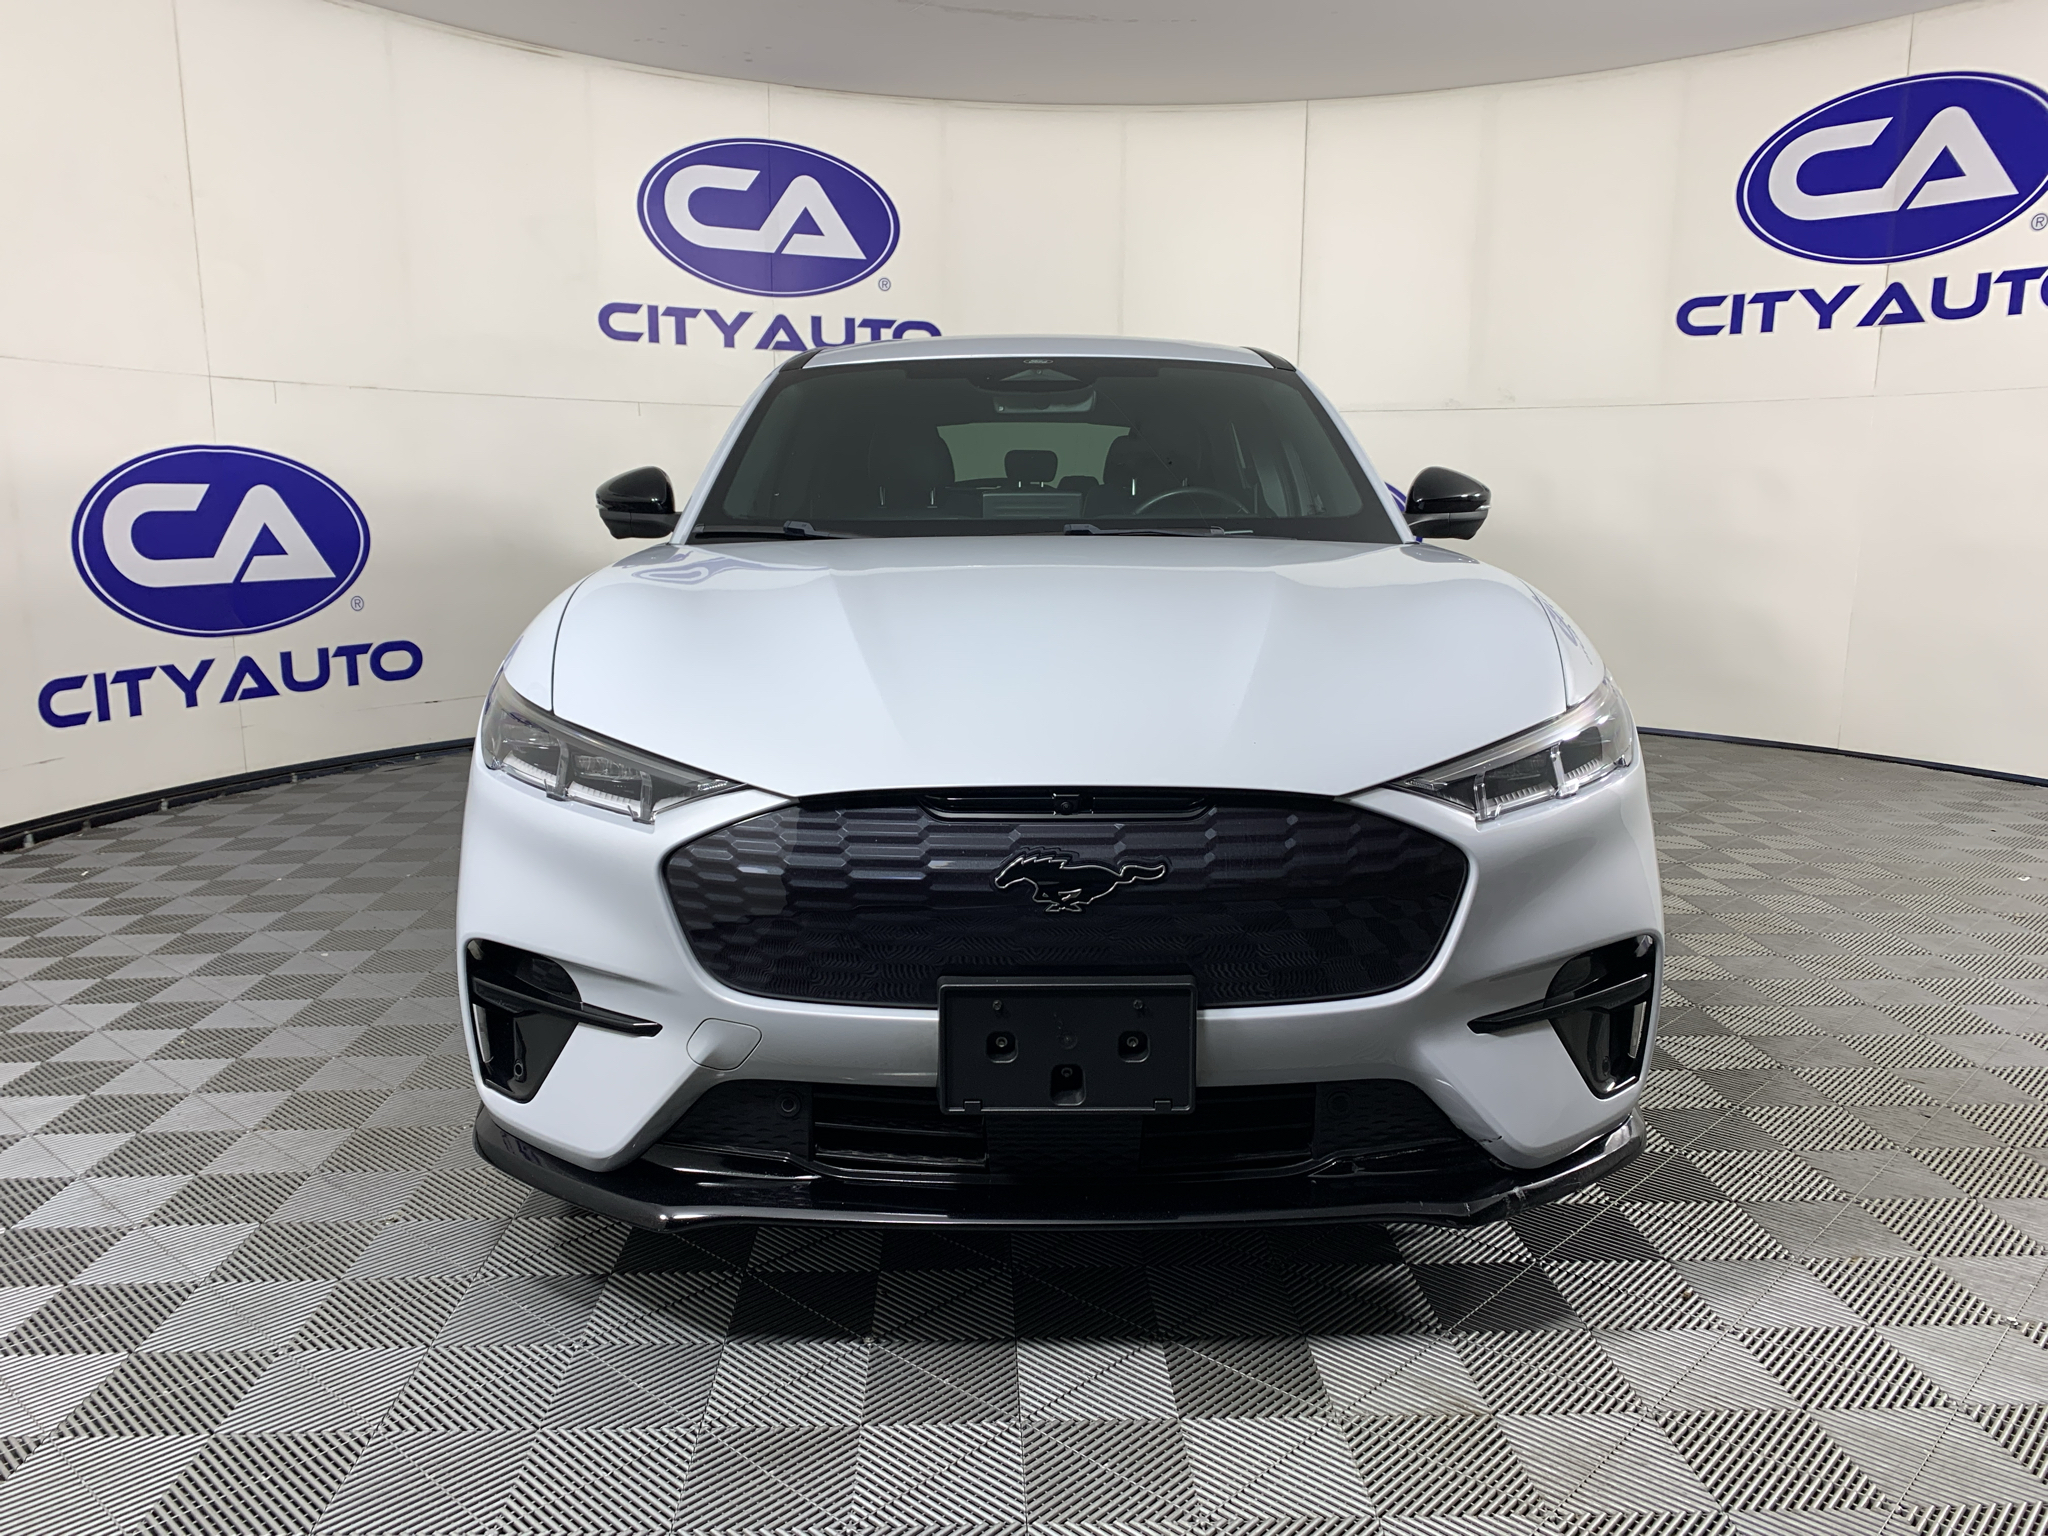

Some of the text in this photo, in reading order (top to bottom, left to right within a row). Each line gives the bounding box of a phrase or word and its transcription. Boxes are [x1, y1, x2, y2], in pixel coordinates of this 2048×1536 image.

[1768, 105, 2020, 221] CA
[664, 164, 867, 260] CA
[598, 302, 752, 350] CITY
[1676, 266, 2048, 336] CITY AUT
[102, 482, 337, 588] CA
[37, 640, 424, 729] CITY AUTO
